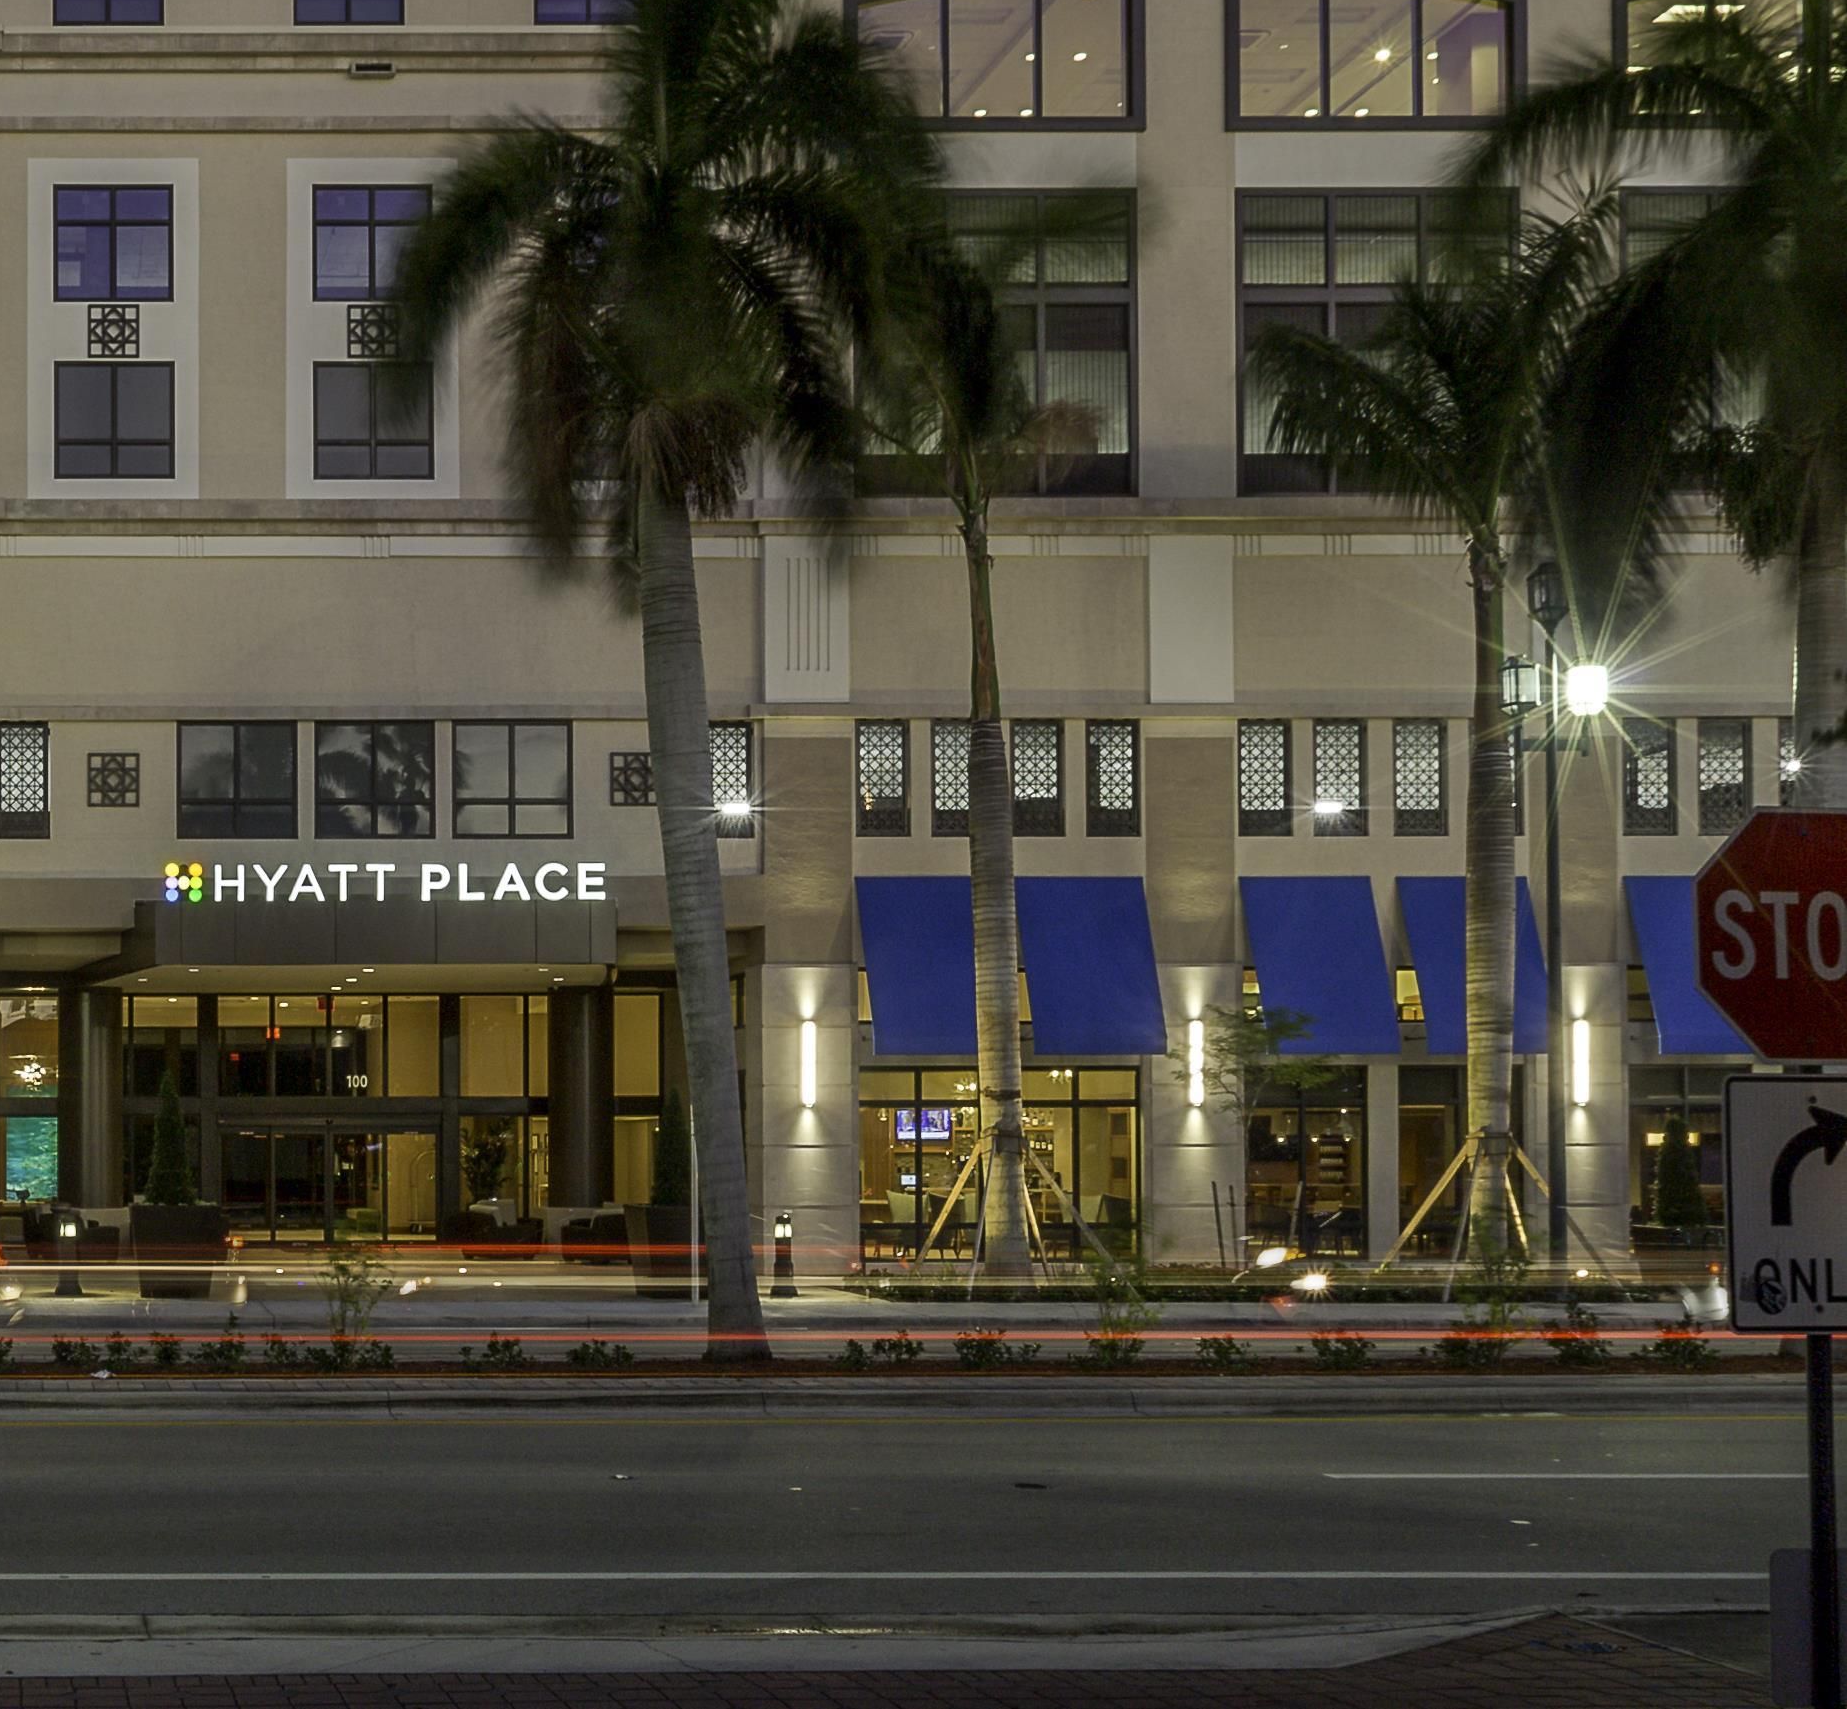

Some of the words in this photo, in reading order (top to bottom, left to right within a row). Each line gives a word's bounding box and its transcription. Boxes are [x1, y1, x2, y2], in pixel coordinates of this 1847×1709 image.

[214, 863, 396, 903] HYATT
[420, 862, 607, 902] PLACE
[346, 1075, 368, 1088] 100
